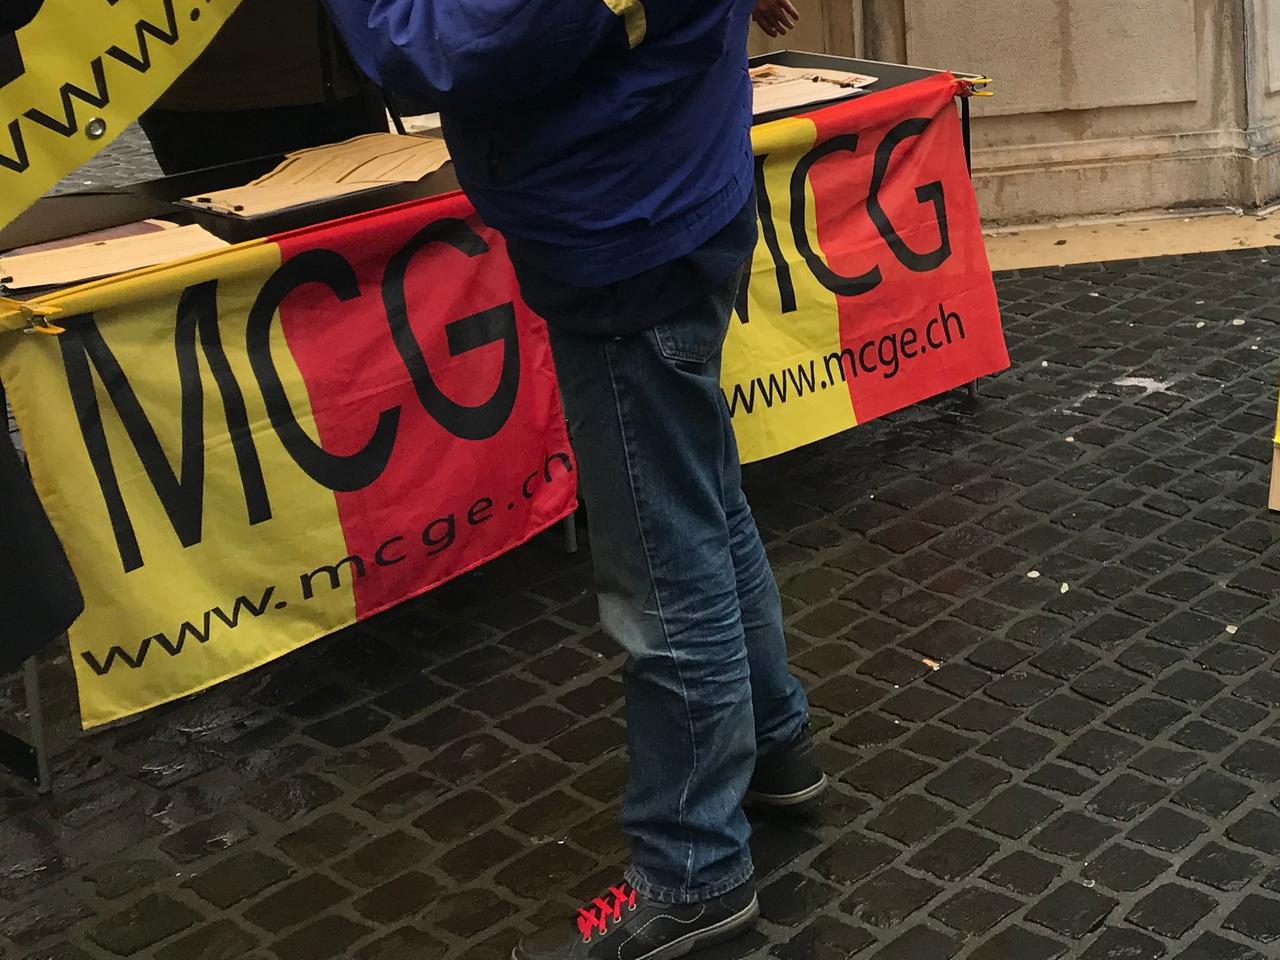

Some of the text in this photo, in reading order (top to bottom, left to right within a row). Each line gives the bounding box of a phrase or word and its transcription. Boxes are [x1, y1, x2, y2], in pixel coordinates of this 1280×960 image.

[61, 216, 521, 574] MCG
[720, 302, 966, 418] www.mcge.ch
[80, 449, 575, 676] www.mcge.ch
